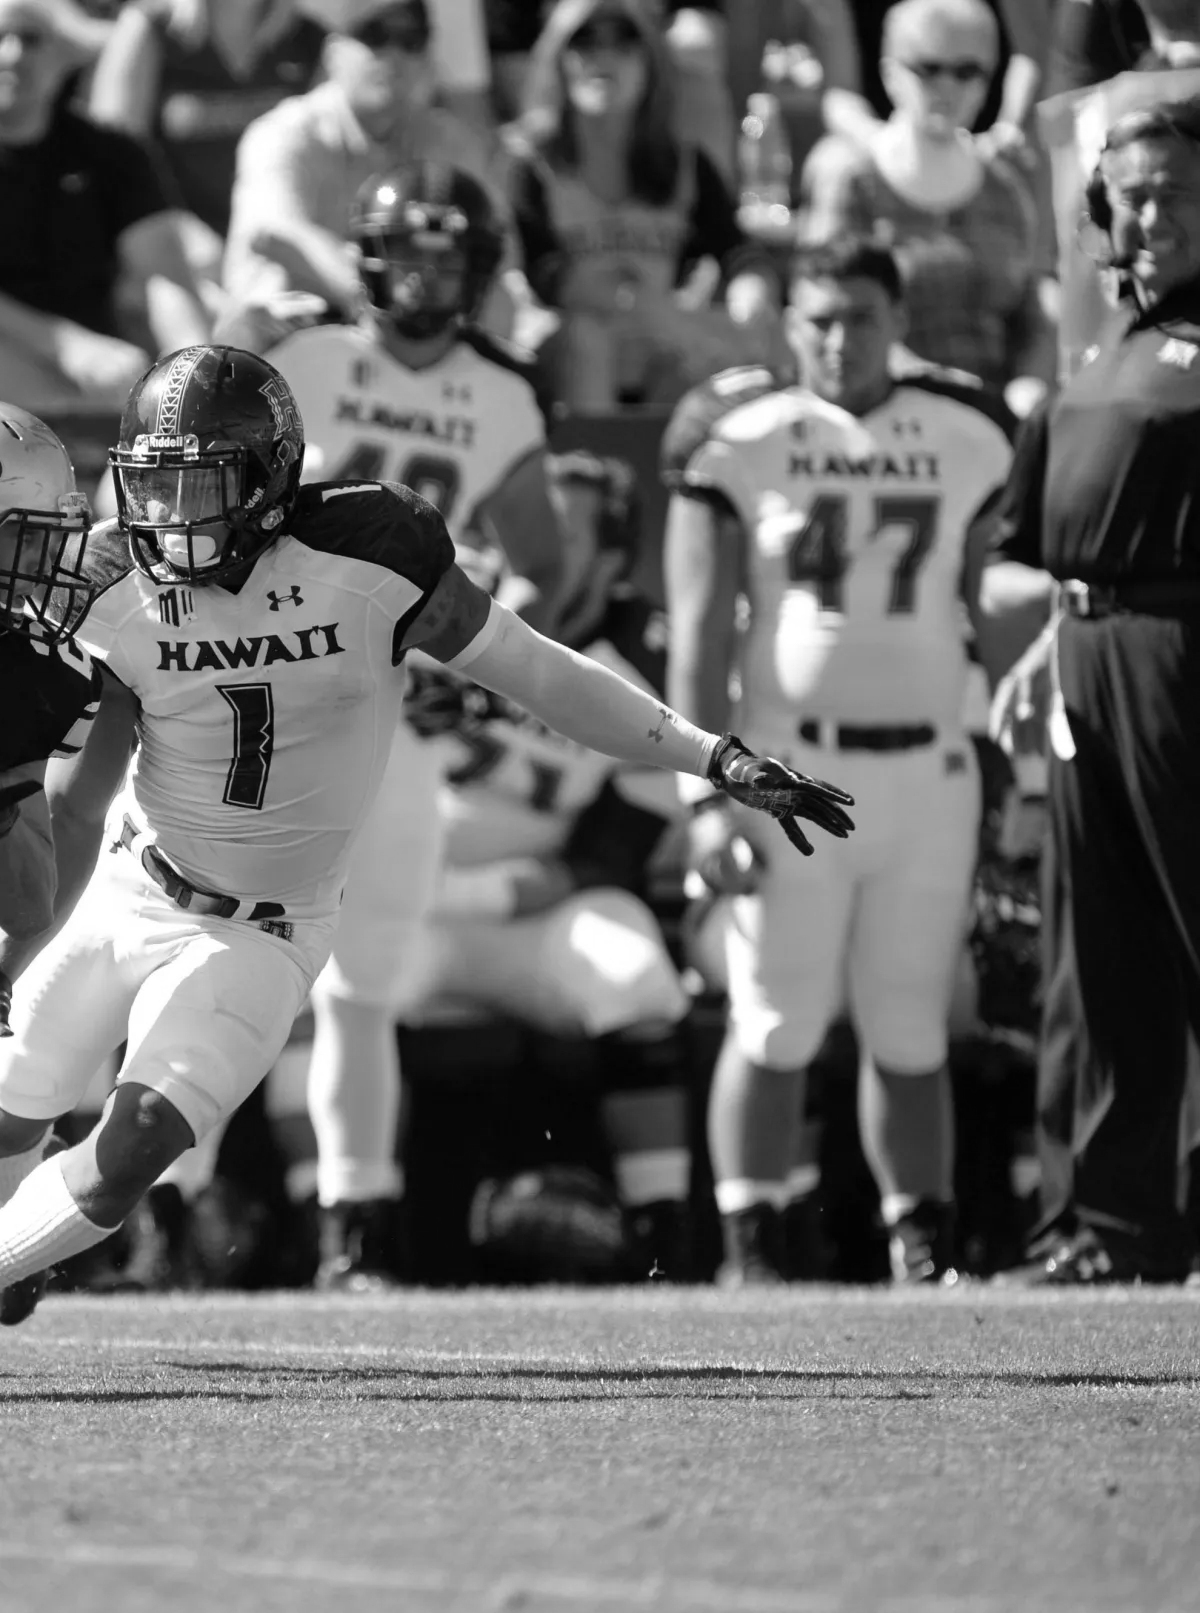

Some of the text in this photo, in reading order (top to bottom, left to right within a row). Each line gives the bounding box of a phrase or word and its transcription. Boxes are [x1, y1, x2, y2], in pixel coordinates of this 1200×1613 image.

[149, 436, 183, 448] Riddell
[787, 494, 942, 614] 47
[214, 682, 275, 811] 1
